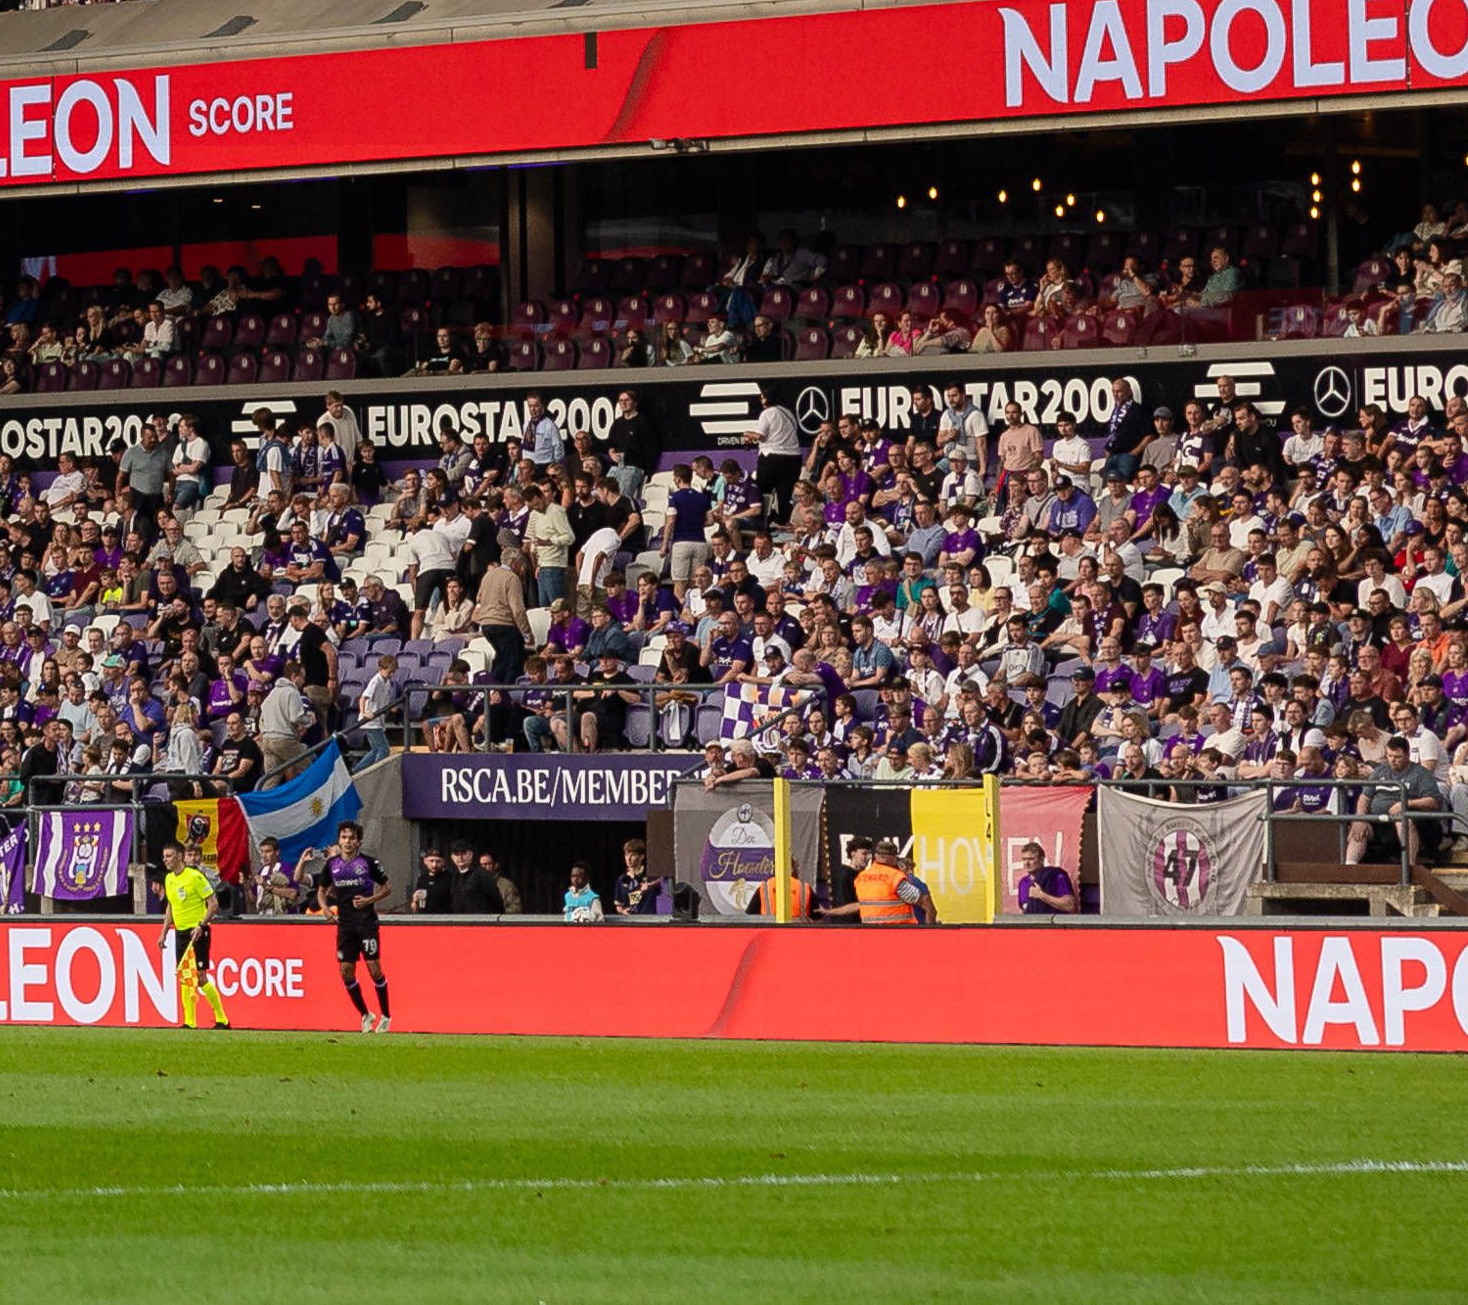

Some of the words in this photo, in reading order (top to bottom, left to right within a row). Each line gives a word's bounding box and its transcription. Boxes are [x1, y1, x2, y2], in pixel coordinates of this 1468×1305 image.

[188, 92, 294, 136] SCORE
[1163, 849, 1199, 886] 47
[362, 937, 378, 955] 79
[1216, 935, 1468, 1046] NAP
